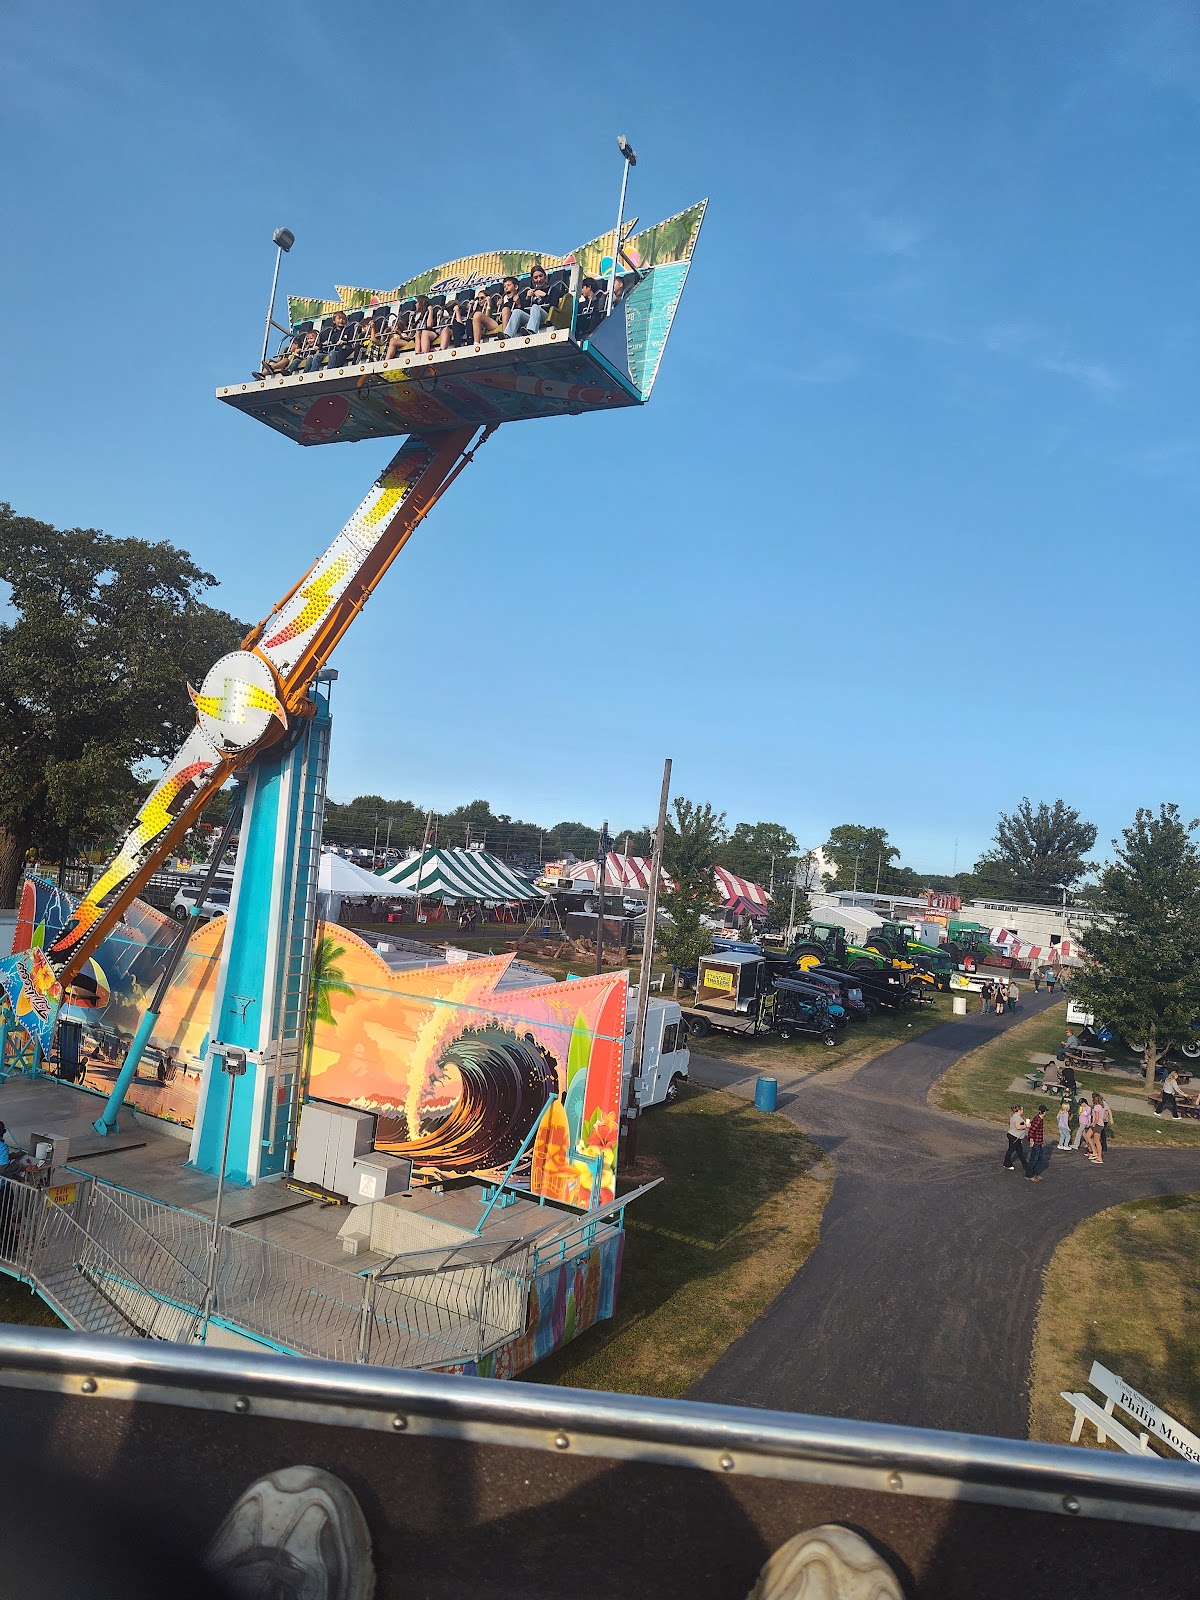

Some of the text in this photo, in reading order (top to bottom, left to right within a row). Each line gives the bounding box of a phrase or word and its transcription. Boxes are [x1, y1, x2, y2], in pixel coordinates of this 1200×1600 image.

[17, 961, 51, 1022] Typhoon
[54, 1195, 69, 1203] ONLY
[56, 1187, 69, 1195] EXIT
[1120, 1392, 1200, 1463] Philip Morga
